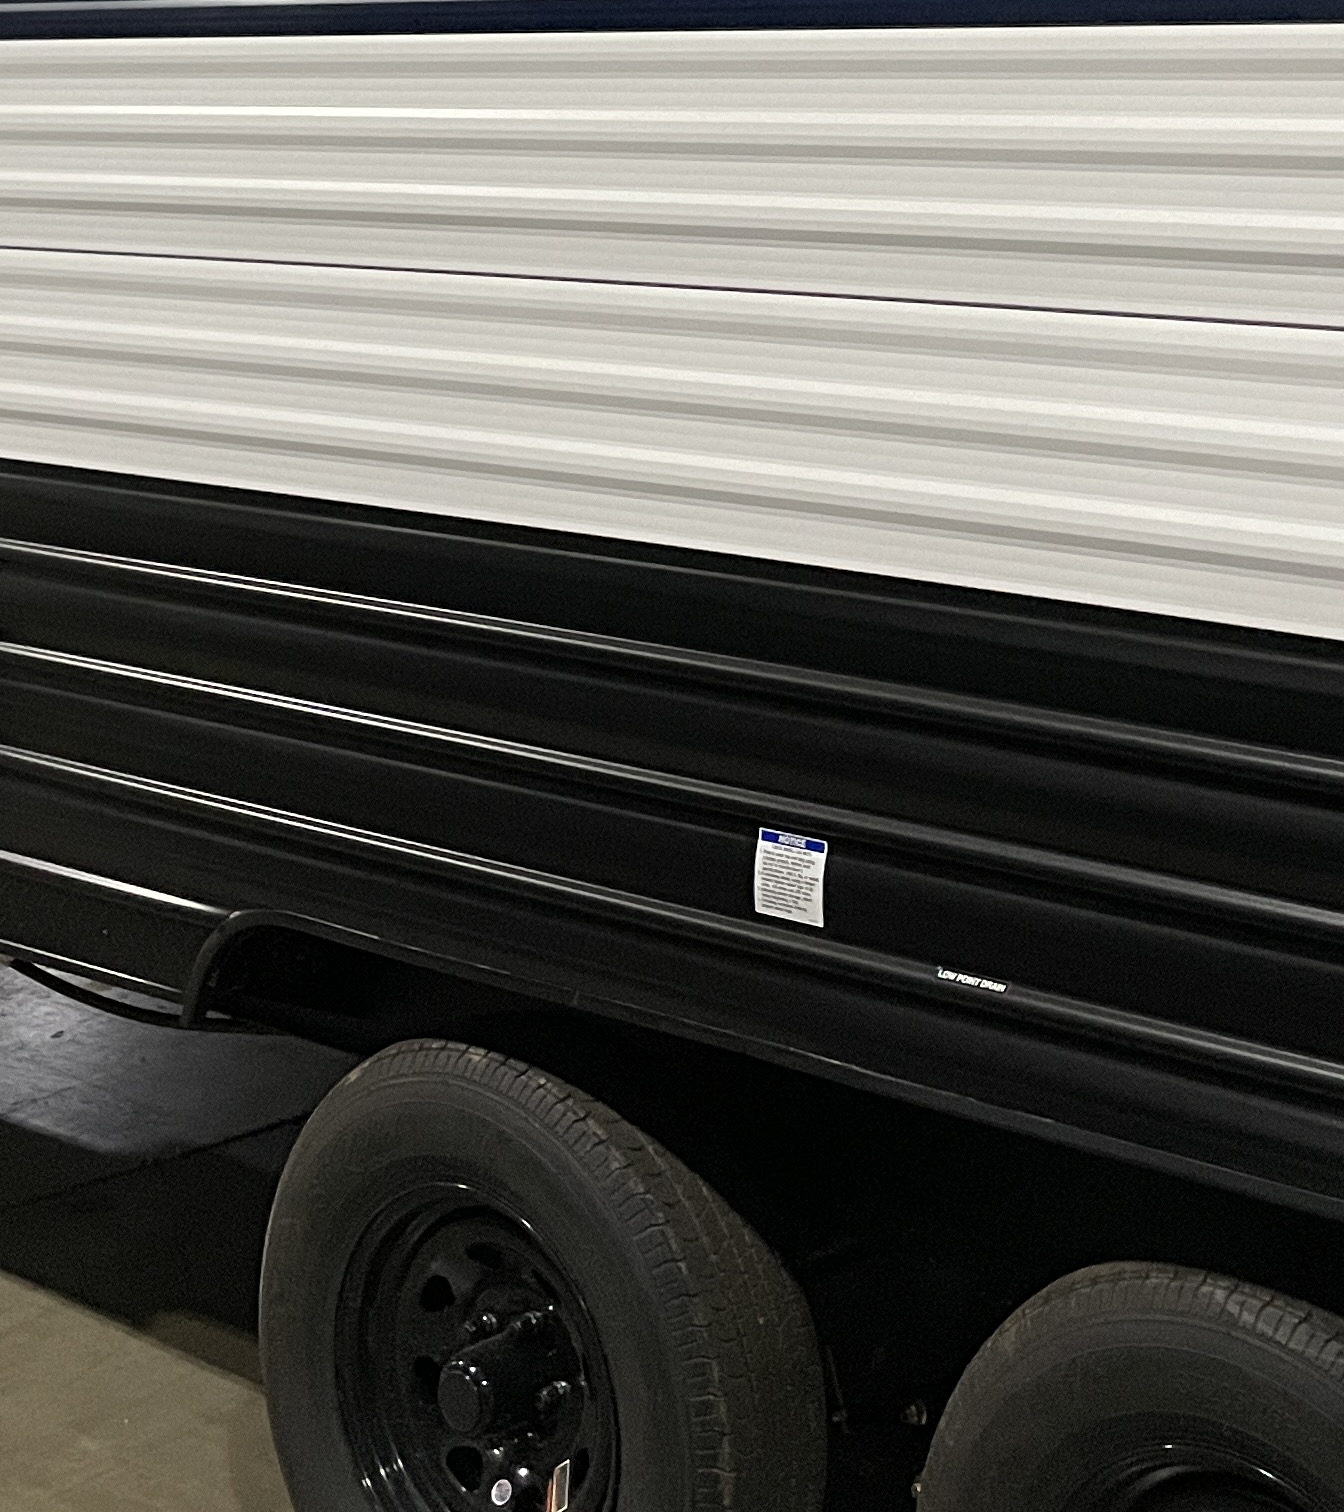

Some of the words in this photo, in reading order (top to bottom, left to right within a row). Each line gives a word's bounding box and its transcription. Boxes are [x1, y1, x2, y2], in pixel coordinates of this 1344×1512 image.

[937, 969, 957, 981] LOW
[956, 973, 982, 987] POINT
[979, 979, 1007, 993] DRAIN
